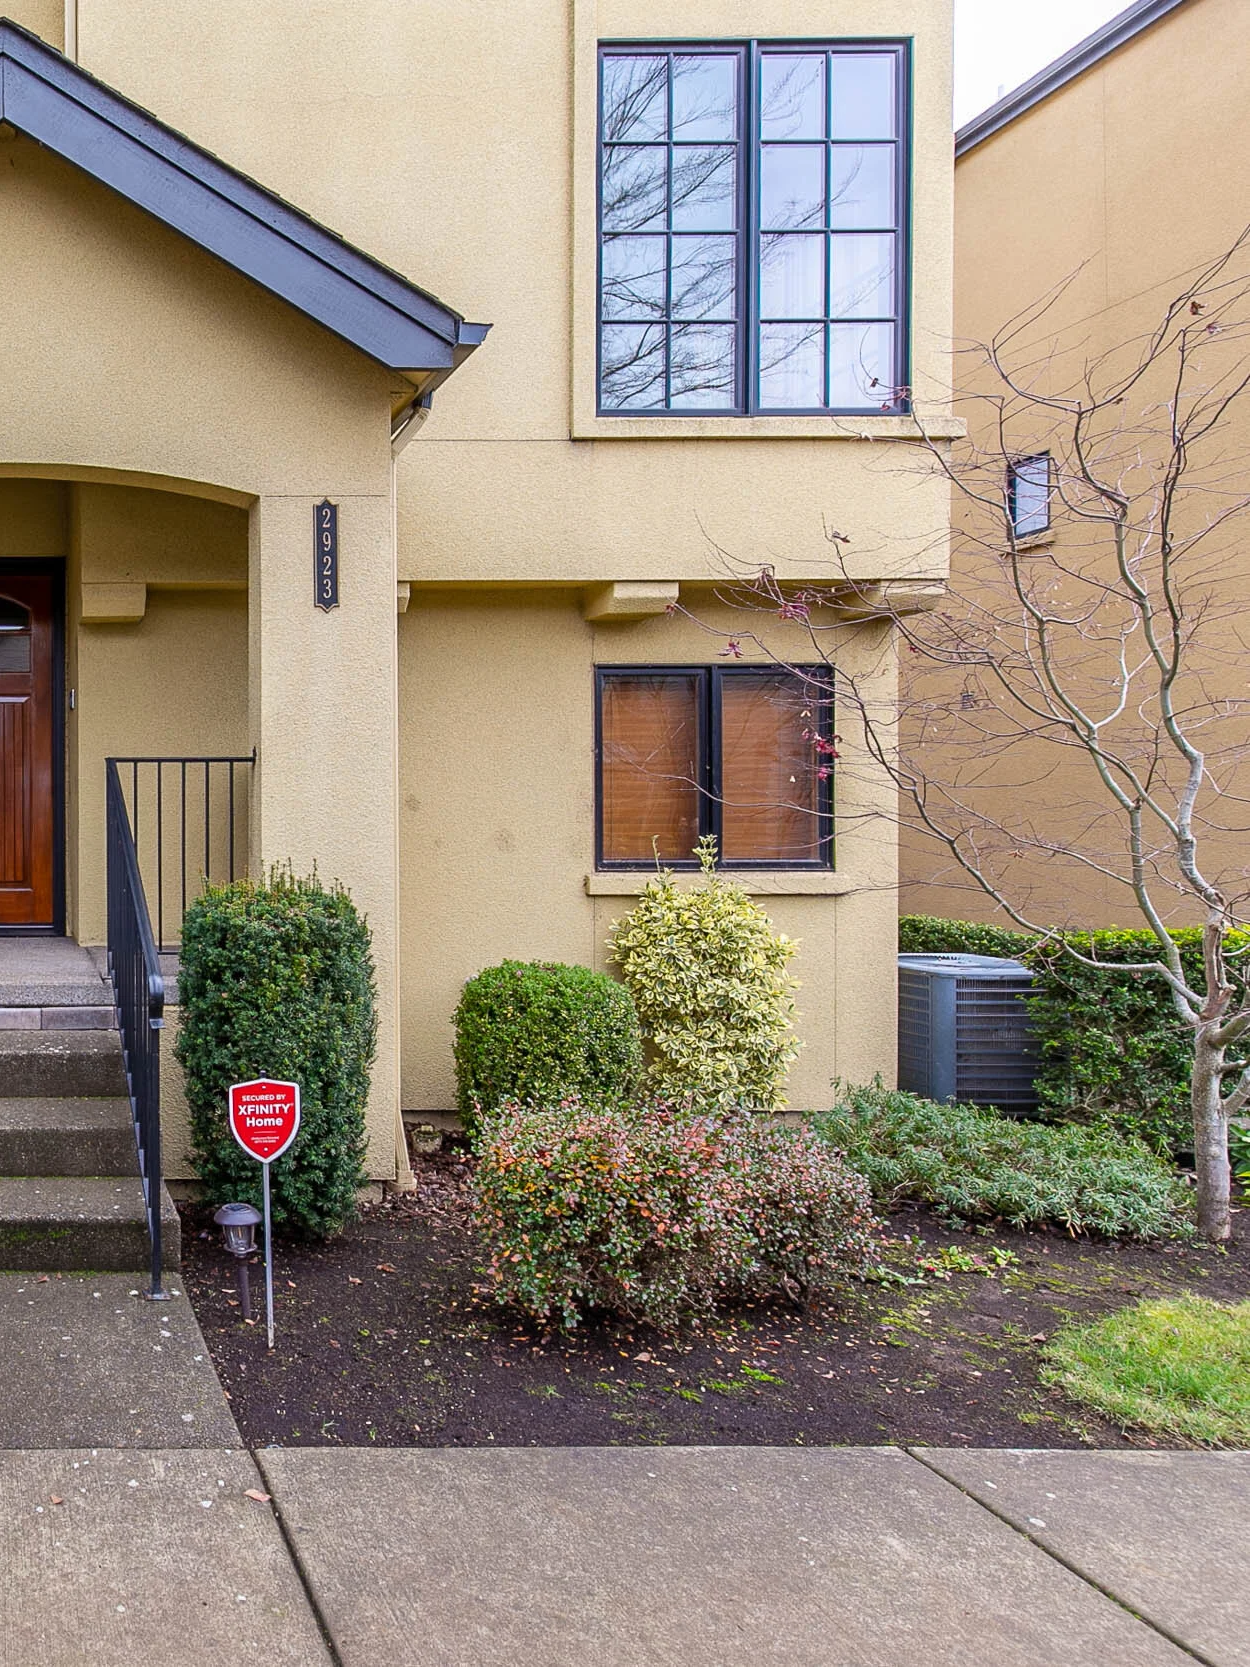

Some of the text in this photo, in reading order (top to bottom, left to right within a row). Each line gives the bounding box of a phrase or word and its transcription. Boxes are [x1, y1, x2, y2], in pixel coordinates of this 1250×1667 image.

[322, 508, 332, 599] 2923
[241, 1094, 275, 1102] SECURED
[238, 1103, 291, 1115] XFINITY
[246, 1117, 284, 1127] Home
